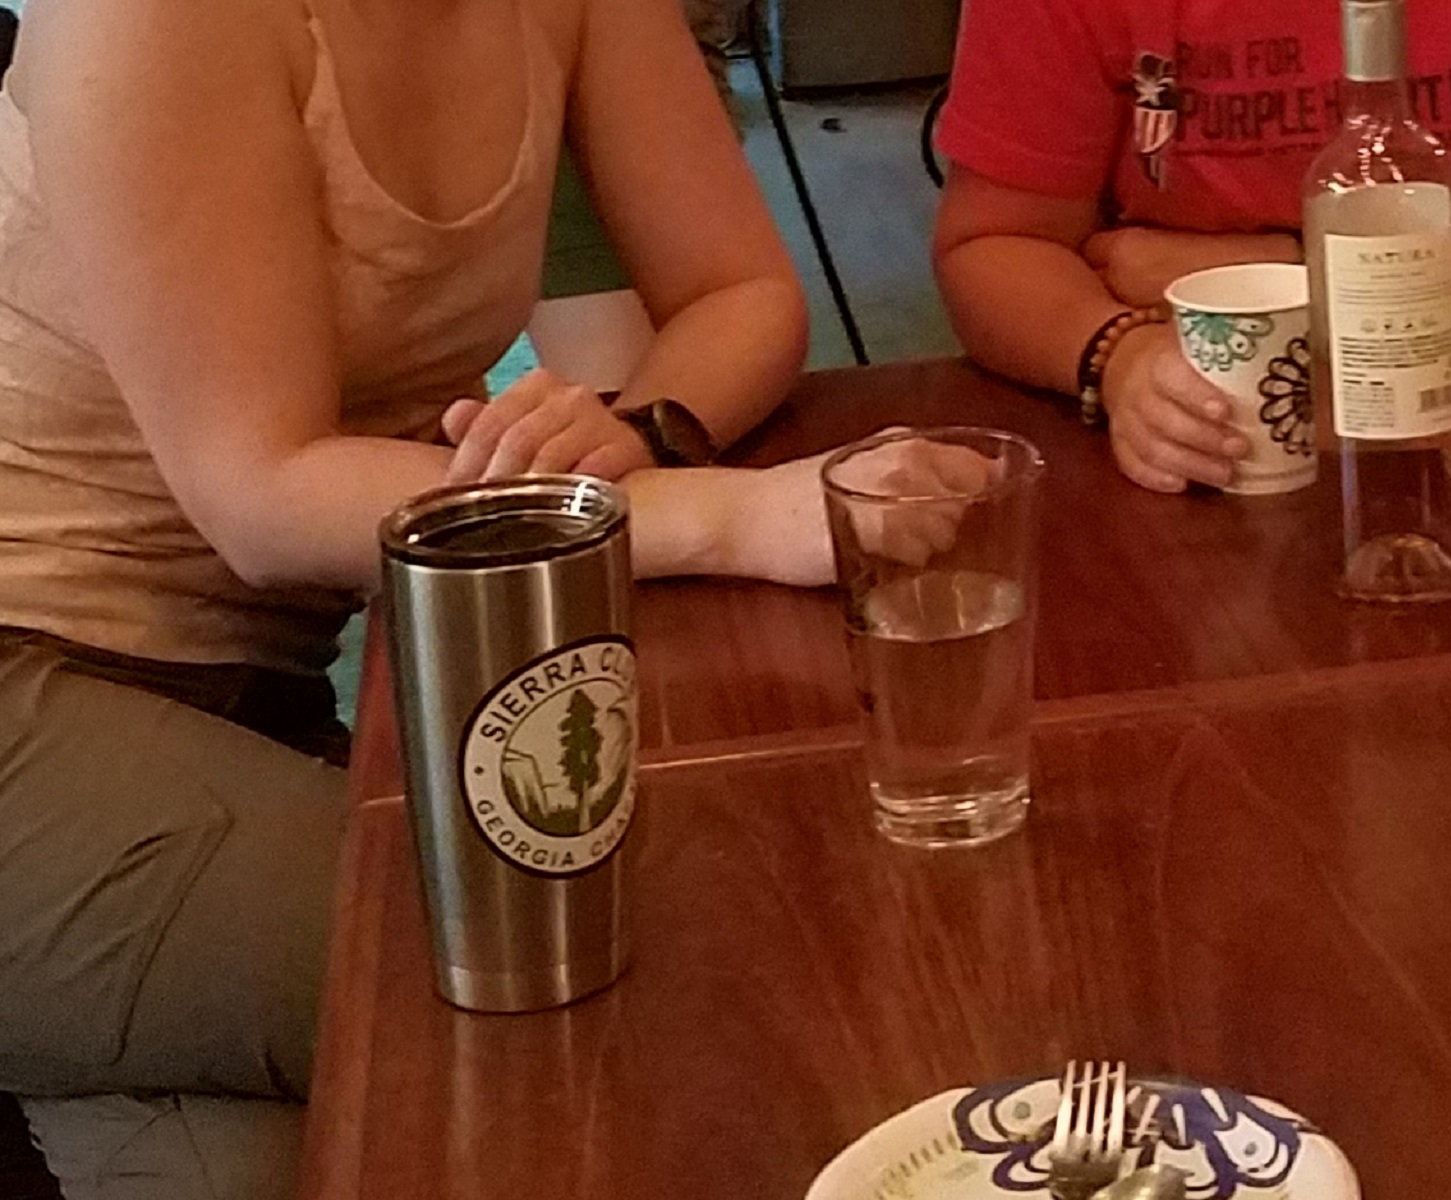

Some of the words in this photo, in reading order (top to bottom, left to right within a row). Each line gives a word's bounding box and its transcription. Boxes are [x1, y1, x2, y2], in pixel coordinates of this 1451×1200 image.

[1246, 36, 1304, 78] FOR
[480, 653, 587, 743] SIERRA
[477, 799, 575, 867] GEORGIA
